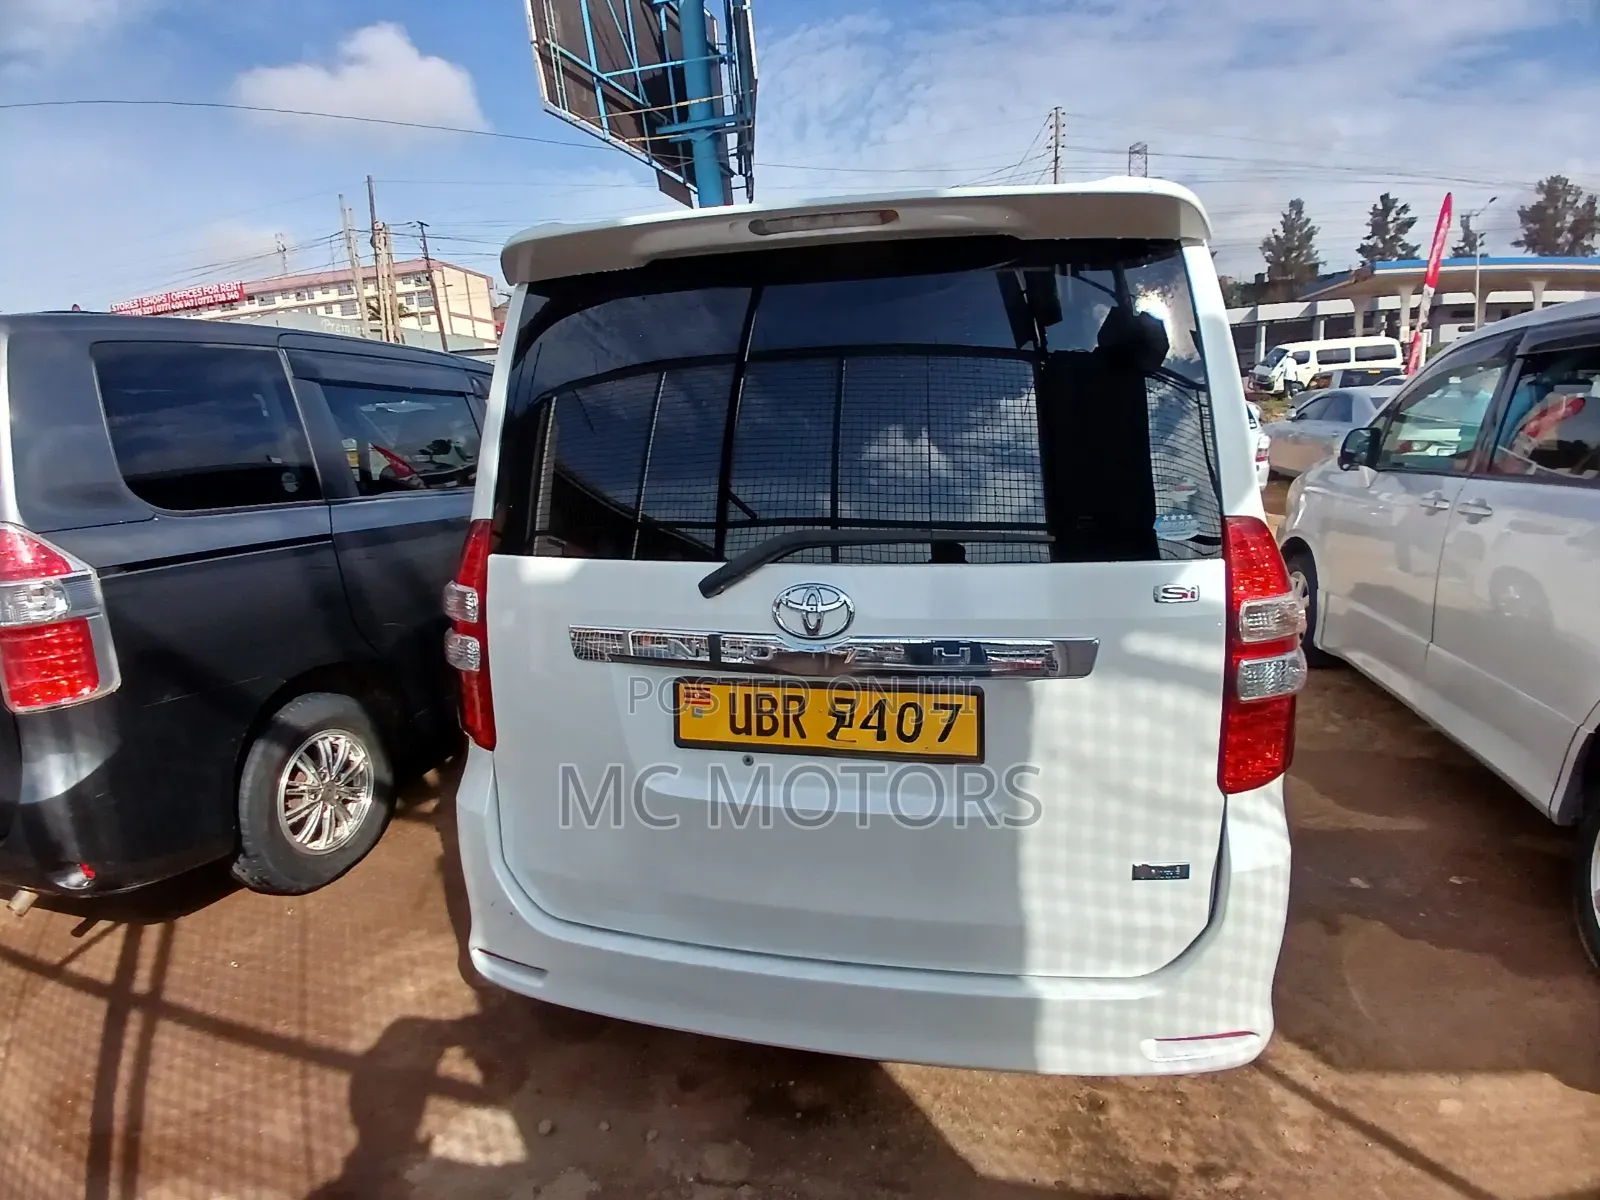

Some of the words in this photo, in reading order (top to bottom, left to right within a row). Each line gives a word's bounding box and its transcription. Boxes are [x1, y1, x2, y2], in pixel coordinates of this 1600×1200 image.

[112, 300, 139, 312] STORES
[142, 295, 167, 306] SHOPS
[171, 288, 203, 301] OFFICES
[203, 284, 219, 295] FOR
[220, 282, 241, 292] RENT
[1161, 586, 1196, 600] Si
[729, 692, 807, 739] UBR
